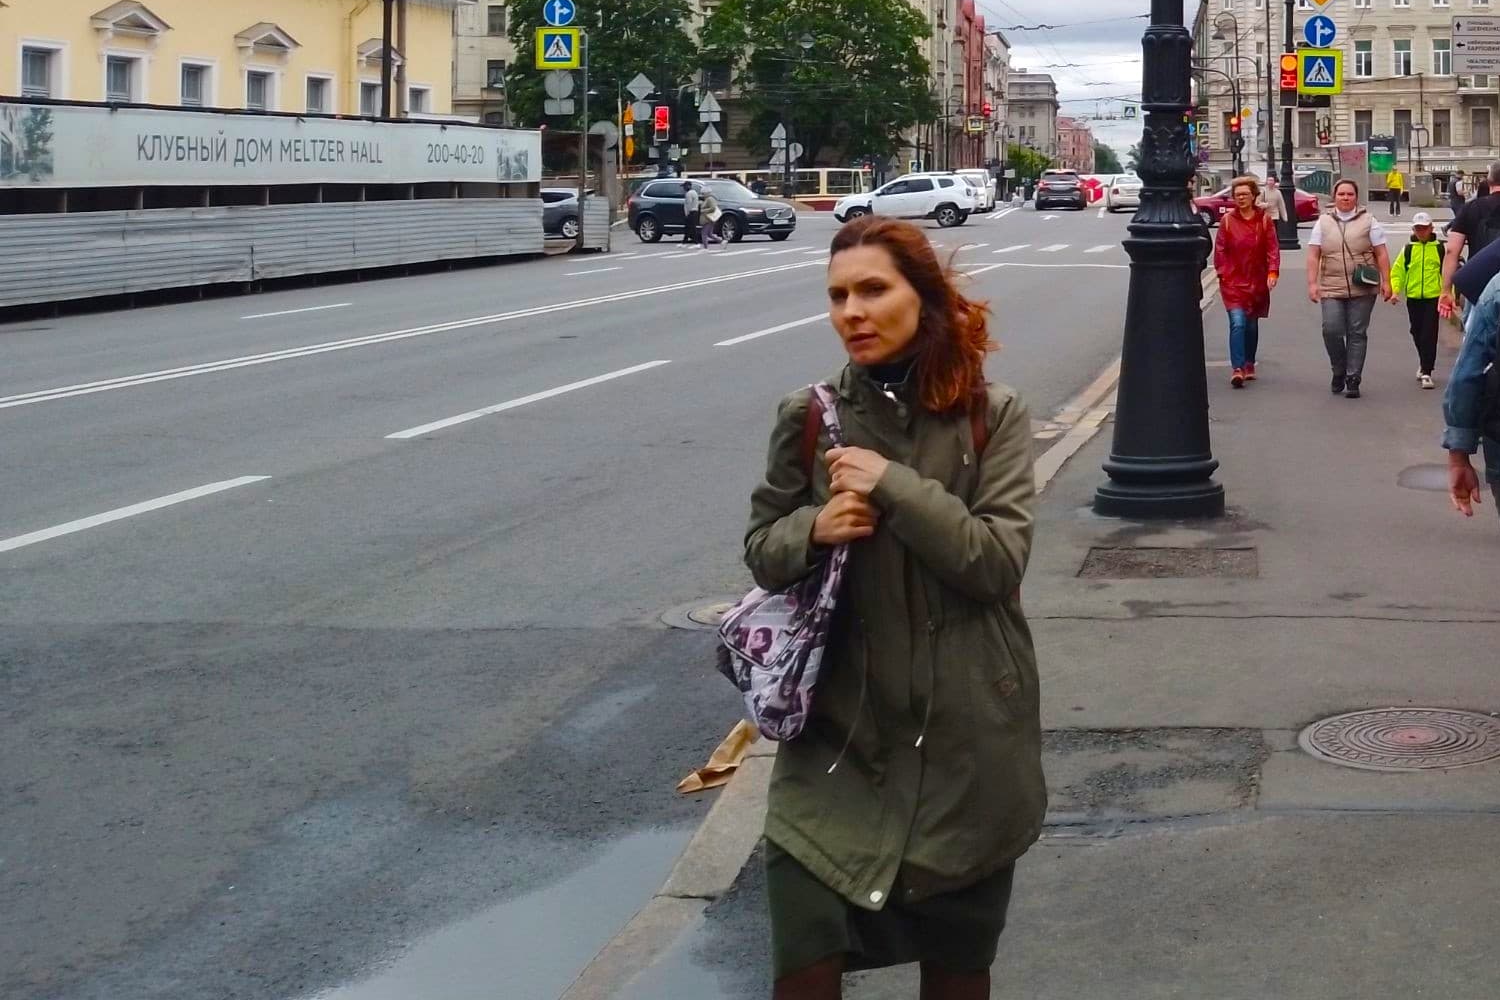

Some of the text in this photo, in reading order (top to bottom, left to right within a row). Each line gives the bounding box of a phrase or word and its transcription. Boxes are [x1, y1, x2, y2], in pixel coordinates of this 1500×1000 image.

[137, 129, 383, 168] КЛУБНЫЙ ДОМ MELTZER HALL
[427, 143, 485, 165] 200-40-20
